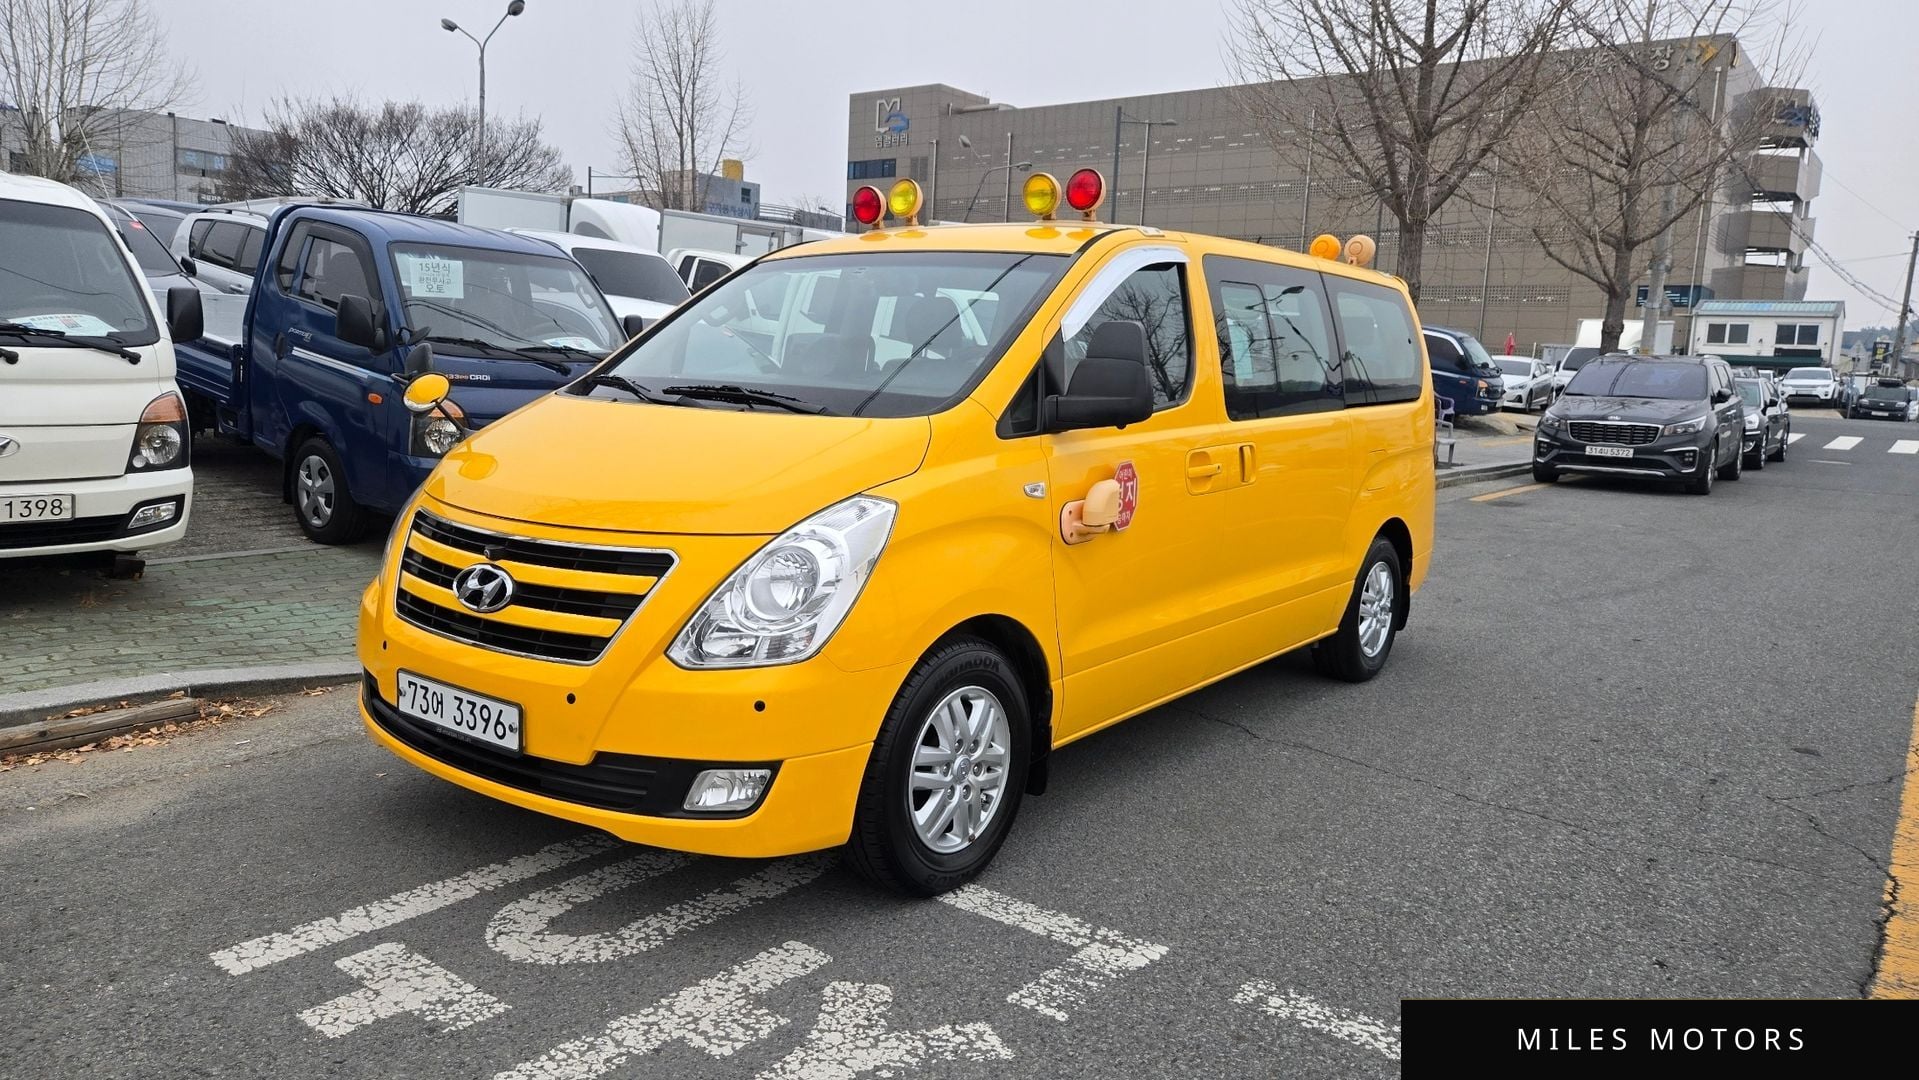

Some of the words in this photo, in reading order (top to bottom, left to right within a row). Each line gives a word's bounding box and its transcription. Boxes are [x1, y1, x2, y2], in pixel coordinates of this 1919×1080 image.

[425, 284, 446, 293] 오토
[4, 498, 63, 518] 1398
[407, 680, 444, 719] 73어
[453, 695, 507, 740] 3396
